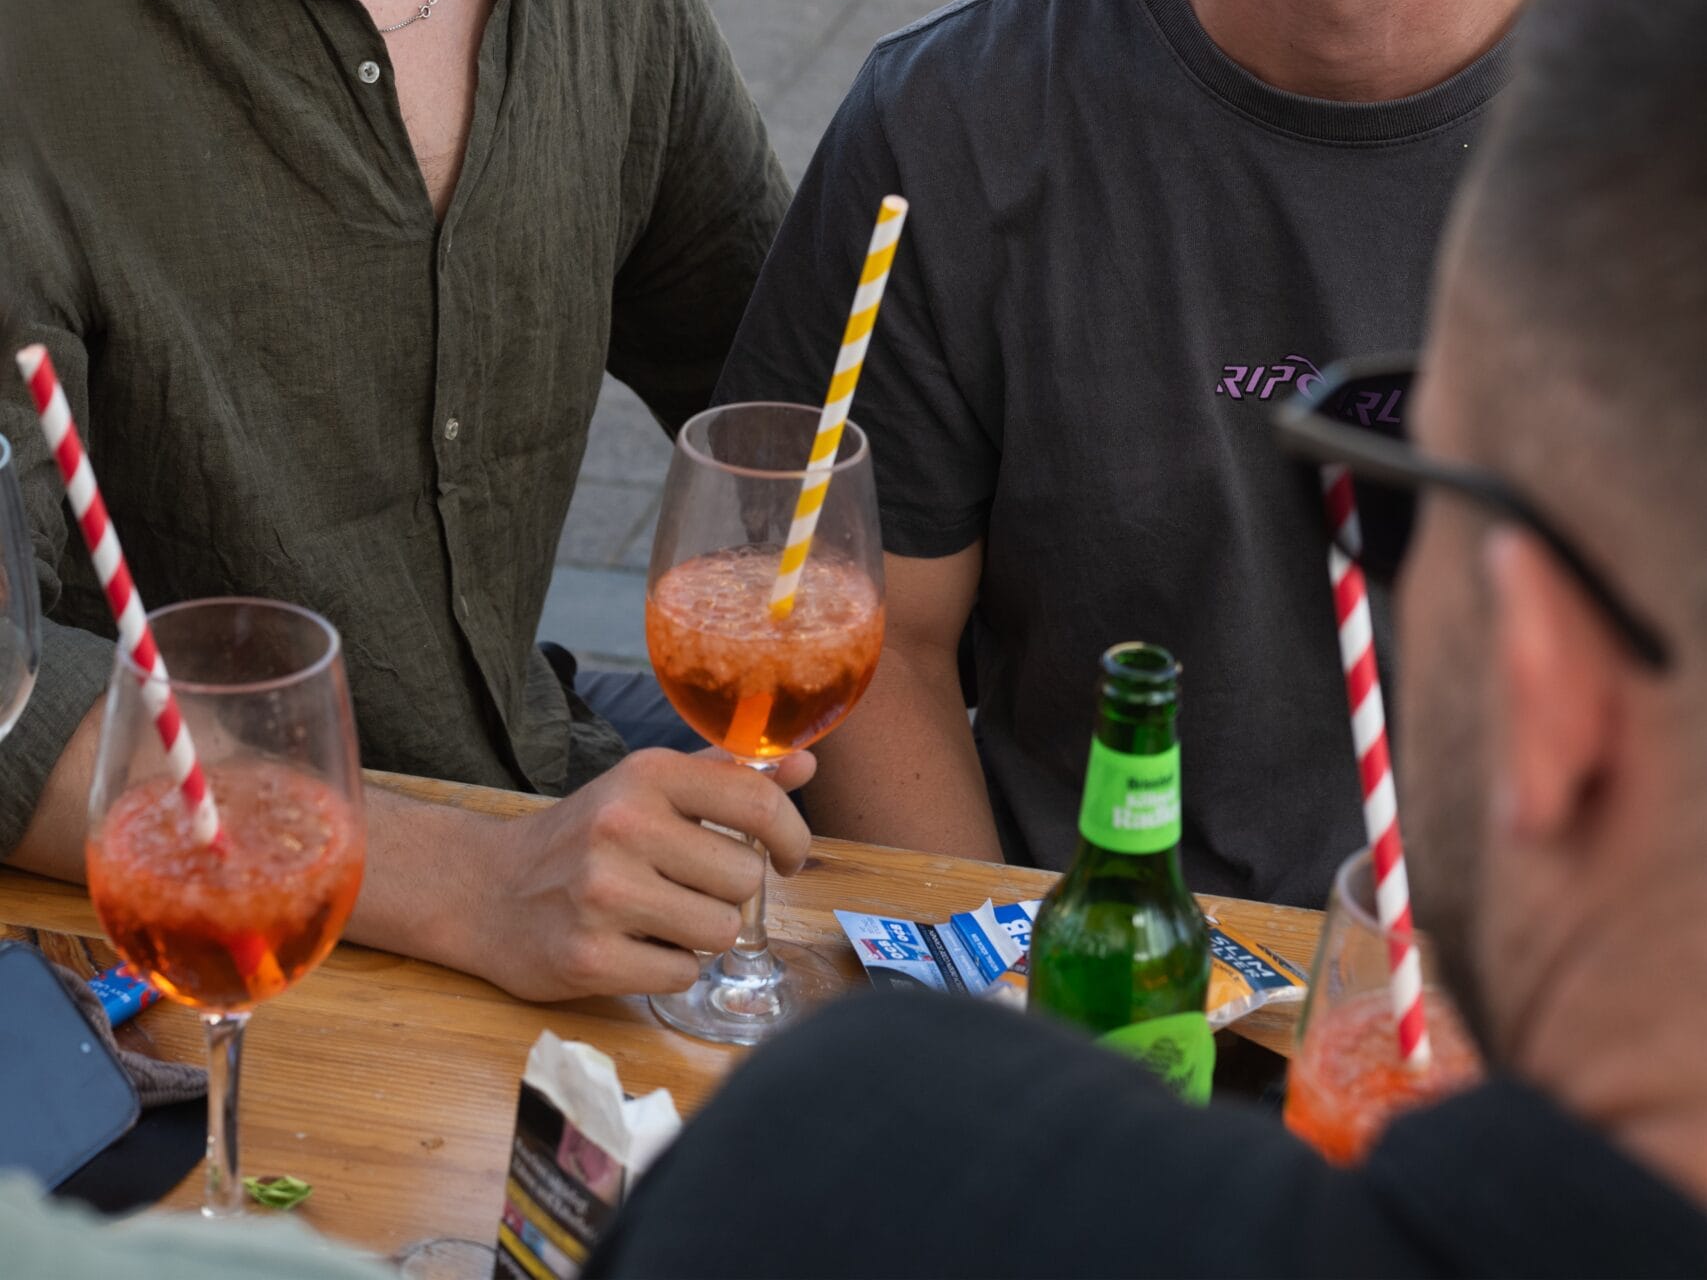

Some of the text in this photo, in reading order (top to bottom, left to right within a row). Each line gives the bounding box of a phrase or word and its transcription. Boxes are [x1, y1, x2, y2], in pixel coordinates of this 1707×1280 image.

[1215, 366, 1296, 399] RIP
[1210, 936, 1276, 977] SLIM
[1212, 946, 1260, 979] LTER
